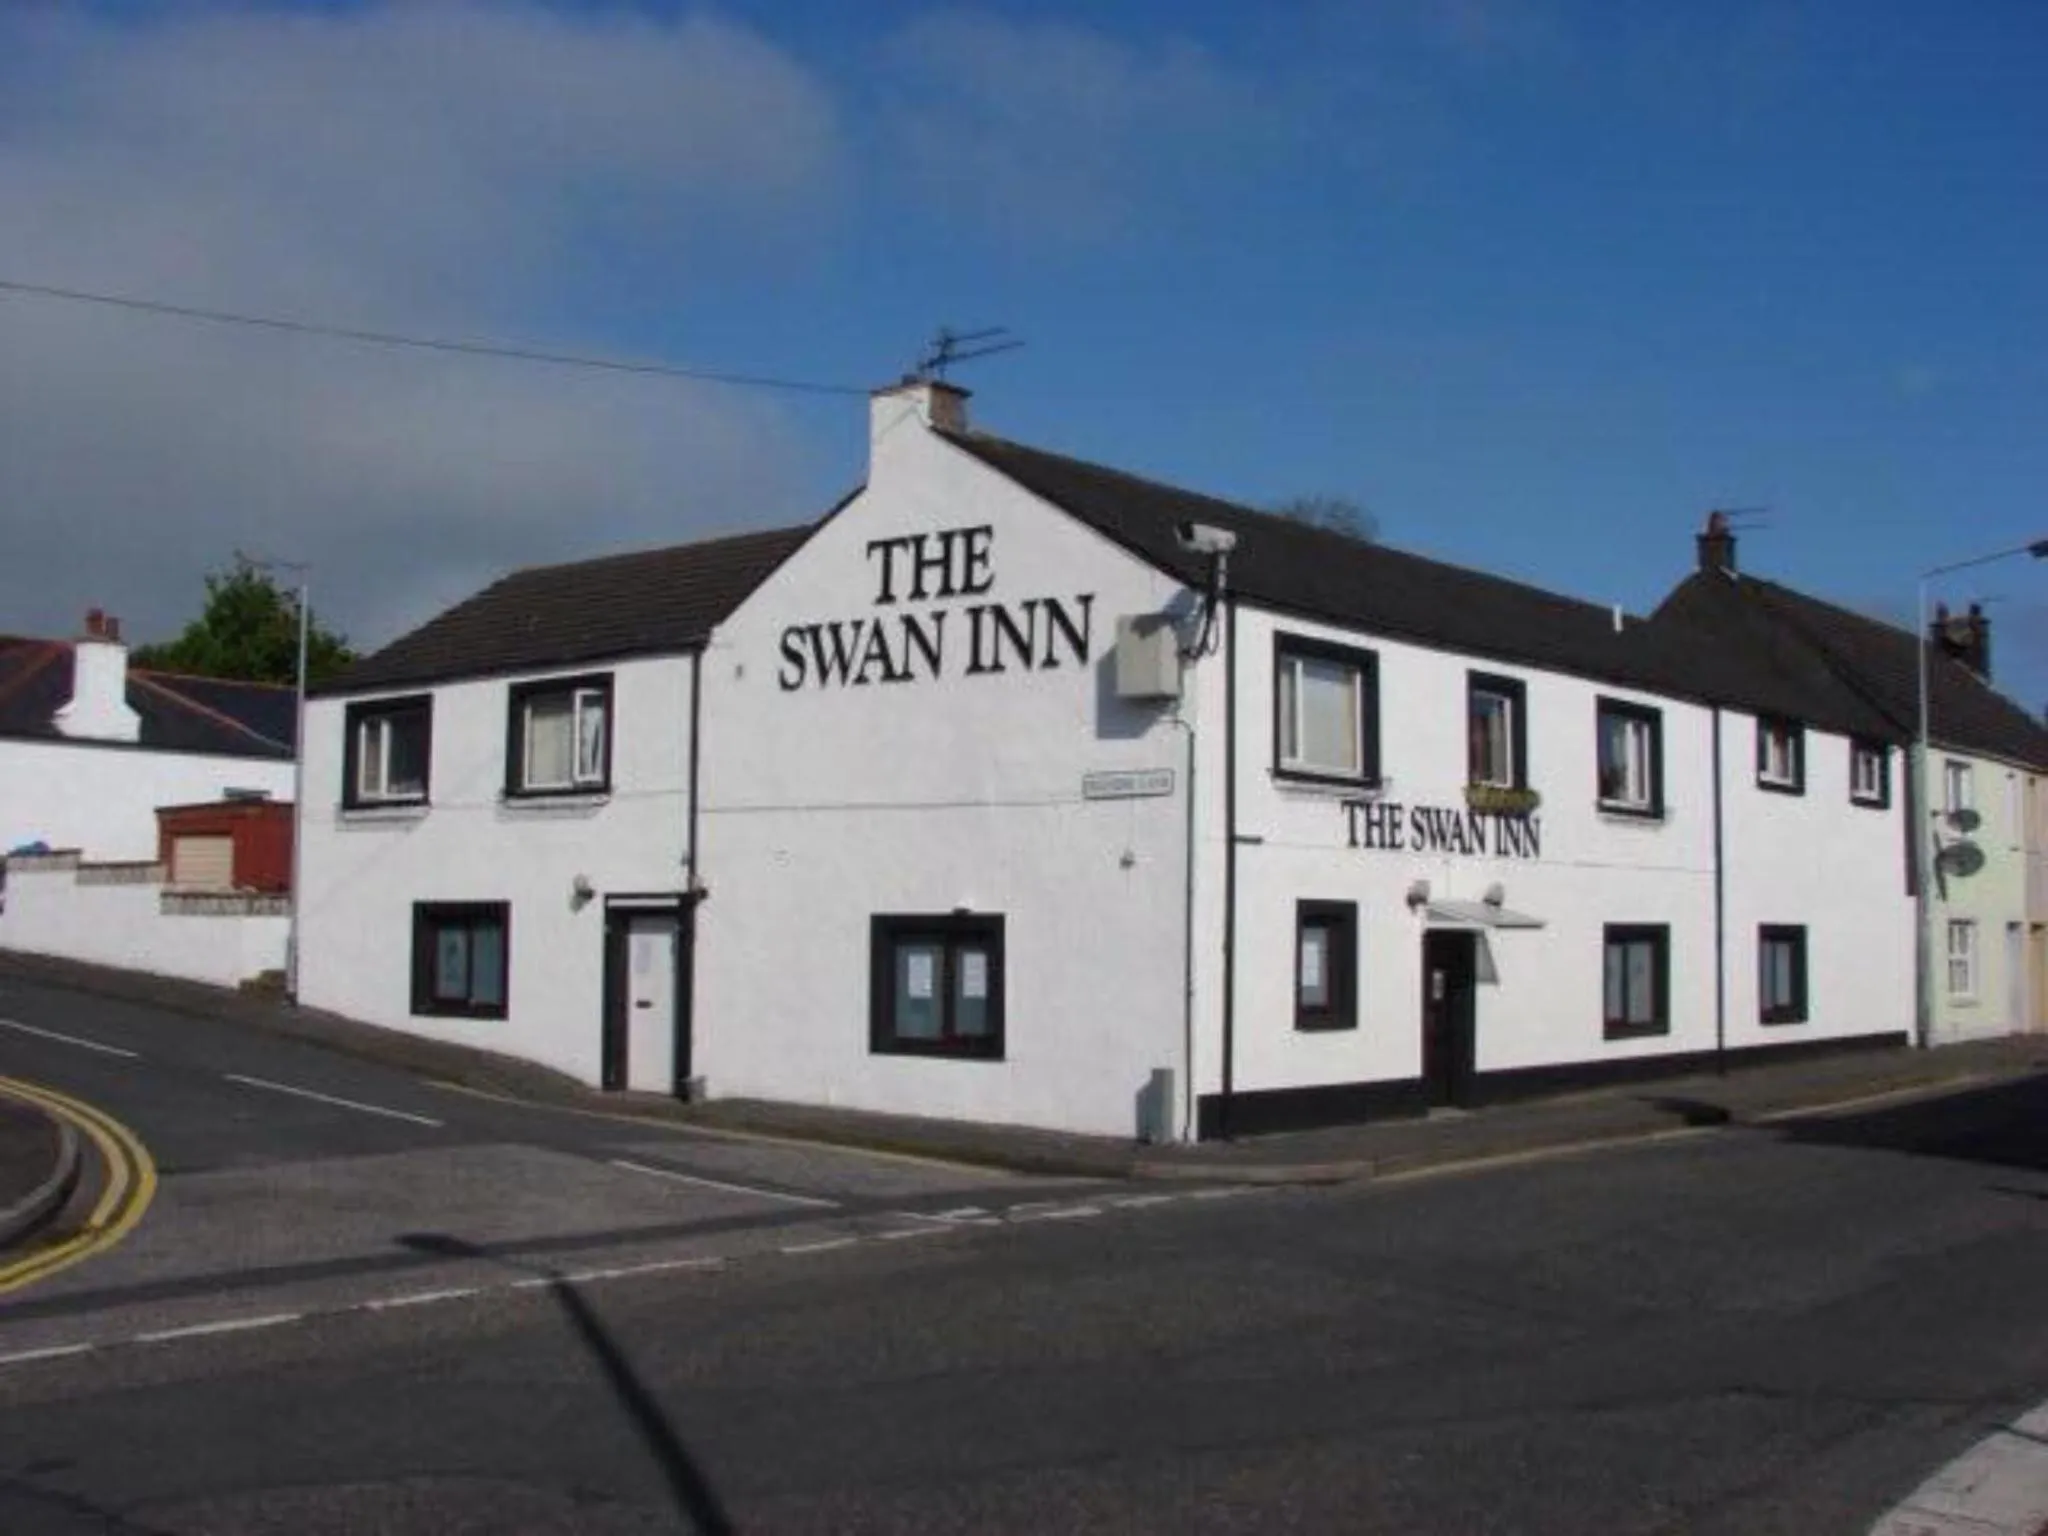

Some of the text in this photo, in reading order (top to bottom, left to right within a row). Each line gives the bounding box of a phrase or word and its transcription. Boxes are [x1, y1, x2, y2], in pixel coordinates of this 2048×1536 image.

[866, 525, 994, 605] THE
[779, 593, 1096, 692] SWAN INN
[1341, 800, 1541, 858] THE SWAN INN
